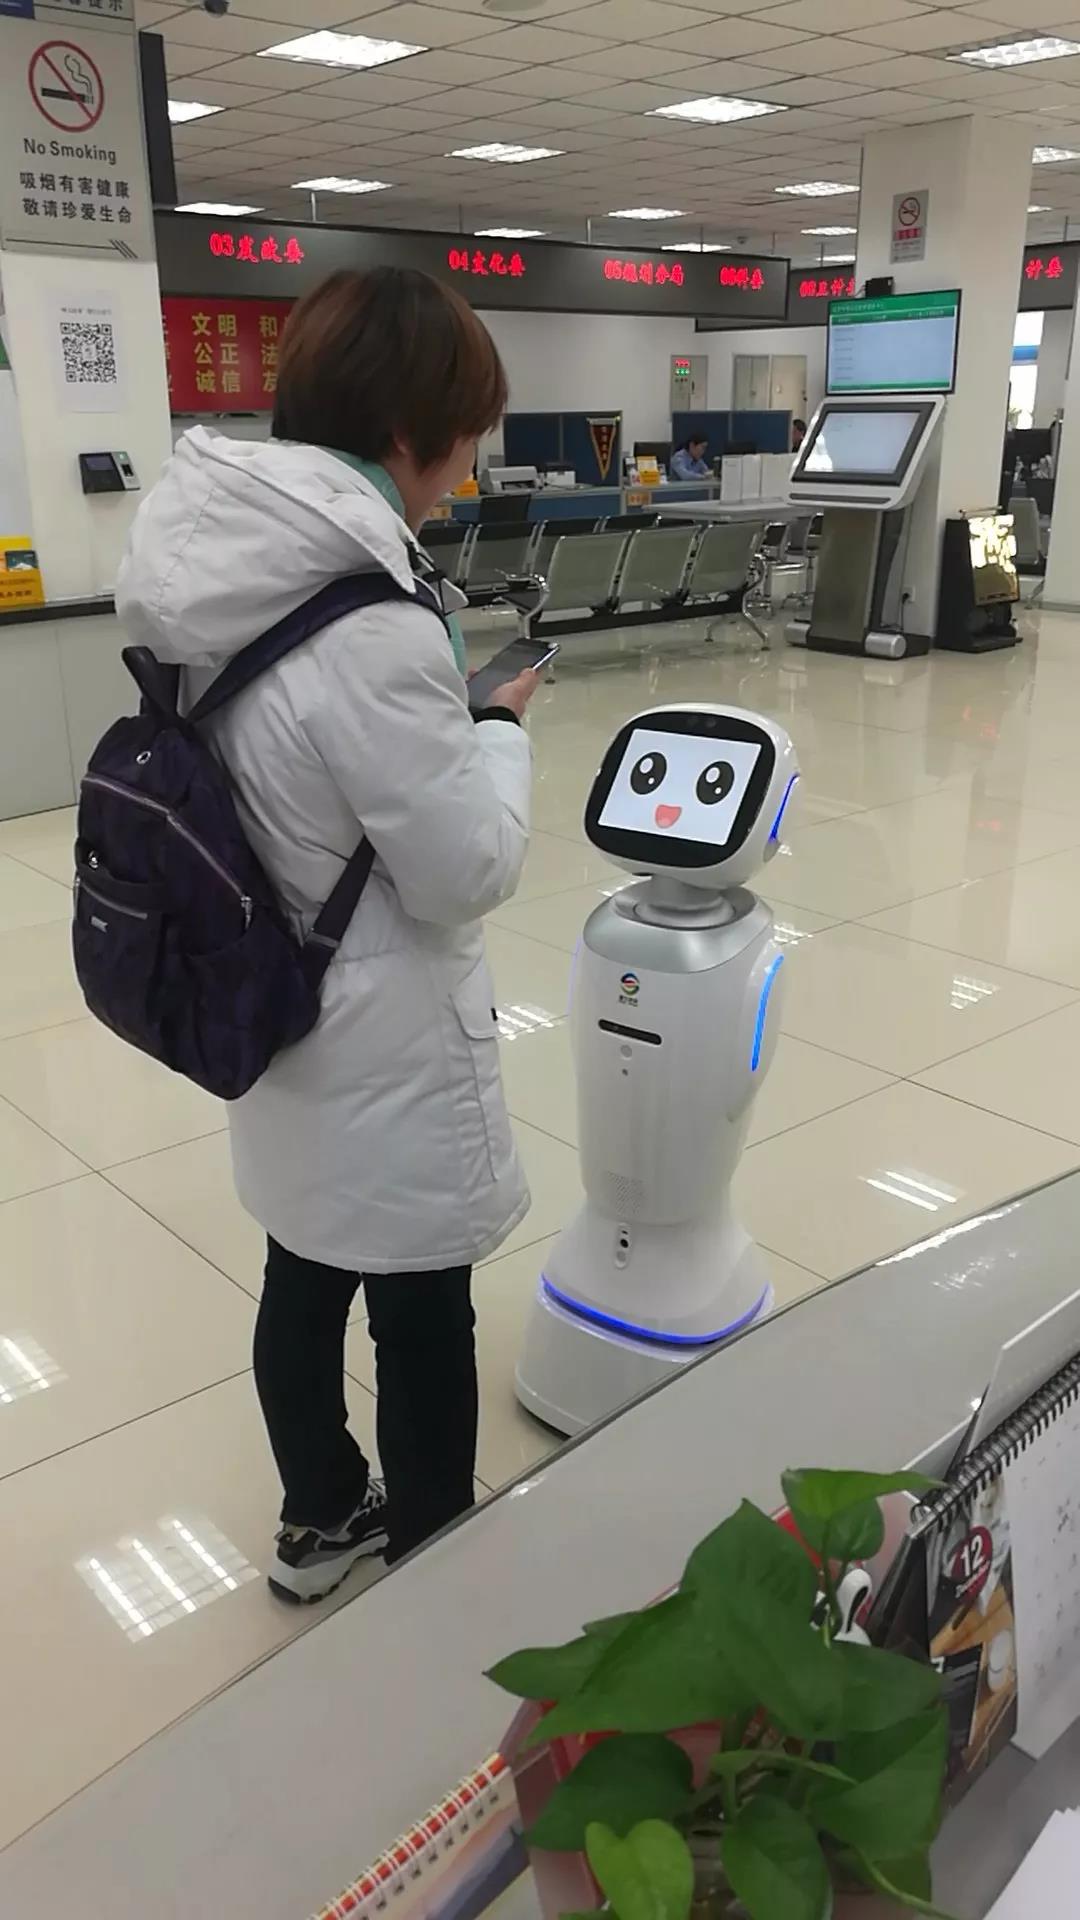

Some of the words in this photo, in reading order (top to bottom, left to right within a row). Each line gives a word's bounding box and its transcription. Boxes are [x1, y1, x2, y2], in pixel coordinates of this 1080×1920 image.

[23, 138, 46, 155] No
[49, 140, 118, 166] Smoking
[19, 171, 131, 199] 吸烟有害健康
[22, 197, 132, 224] 敬请珍爱生命
[191, 312, 238, 337] 文明
[193, 342, 241, 365] 公正
[195, 370, 242, 393] 诚信
[959, 1534, 985, 1578] 12
